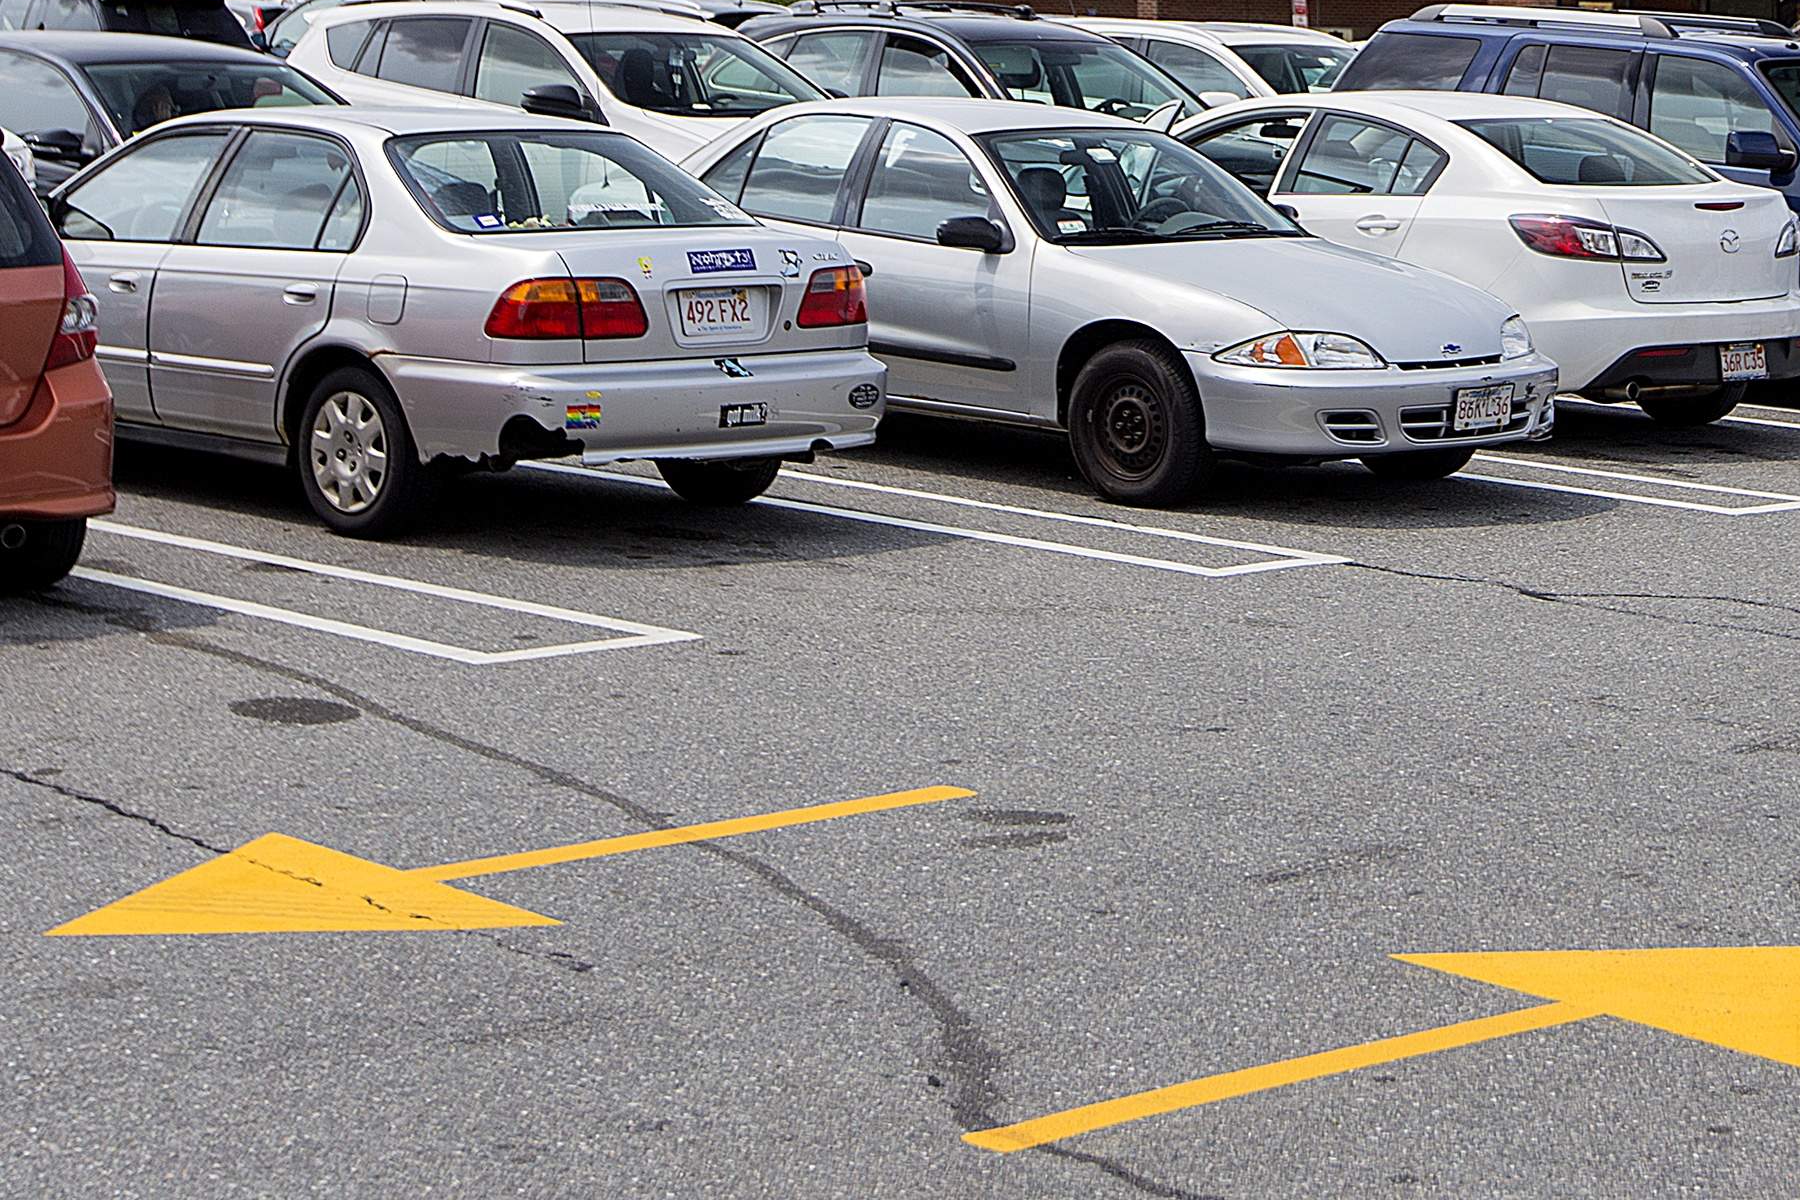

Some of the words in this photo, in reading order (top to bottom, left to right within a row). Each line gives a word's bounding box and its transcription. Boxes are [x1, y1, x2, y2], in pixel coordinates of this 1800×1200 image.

[686, 300, 716, 325] 492
[719, 298, 751, 323] FX2
[1722, 353, 1742, 373] 36R
[1744, 351, 1765, 371] C35
[727, 406, 742, 427] got
[742, 403, 767, 423] milk?
